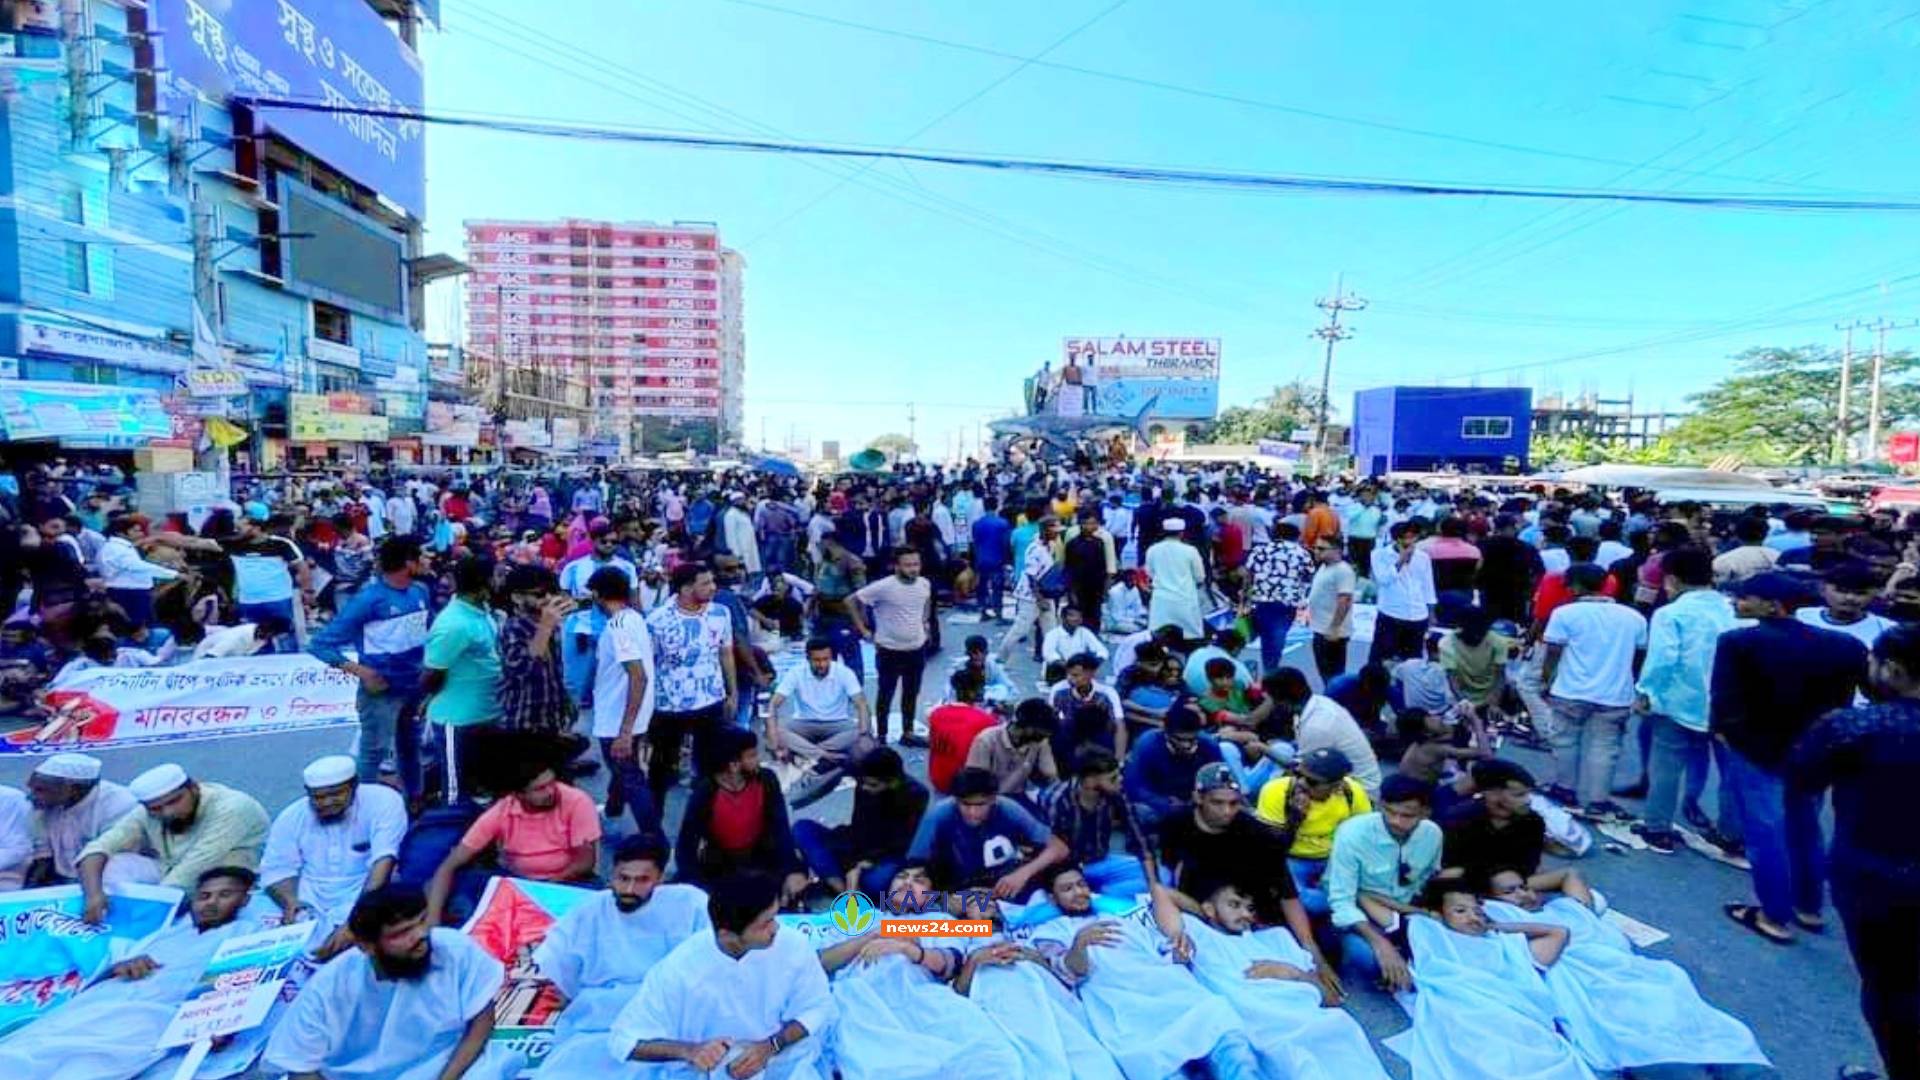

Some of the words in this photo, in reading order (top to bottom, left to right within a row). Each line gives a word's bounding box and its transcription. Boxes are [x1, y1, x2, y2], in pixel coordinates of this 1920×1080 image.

[319, 37, 335, 69] ও
[1067, 340, 1146, 355] SALAM
[1151, 341, 1216, 356] STEEL
[135, 706, 249, 728] মানববন্ধন
